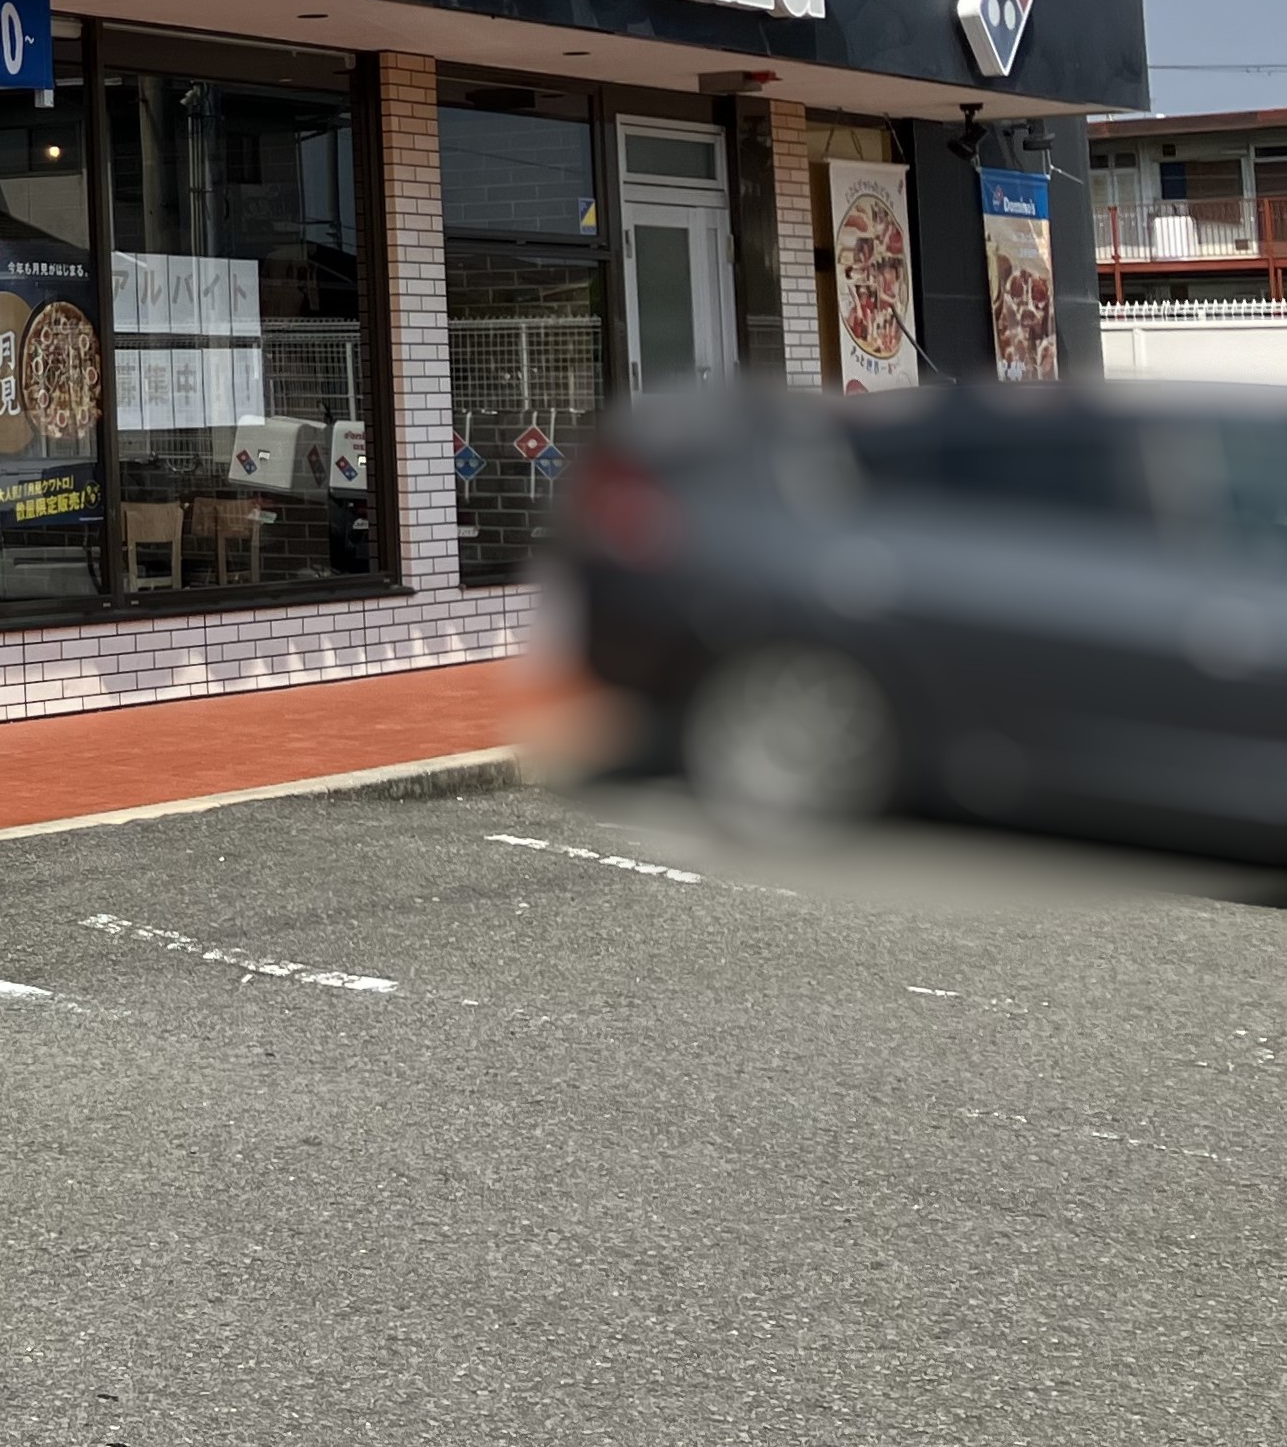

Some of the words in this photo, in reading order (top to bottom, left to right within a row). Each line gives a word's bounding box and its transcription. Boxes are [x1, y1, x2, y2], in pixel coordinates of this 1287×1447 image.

[7, 260, 89, 278] 今年も月見がはじまる。
[112, 269, 248, 313] アルバイト
